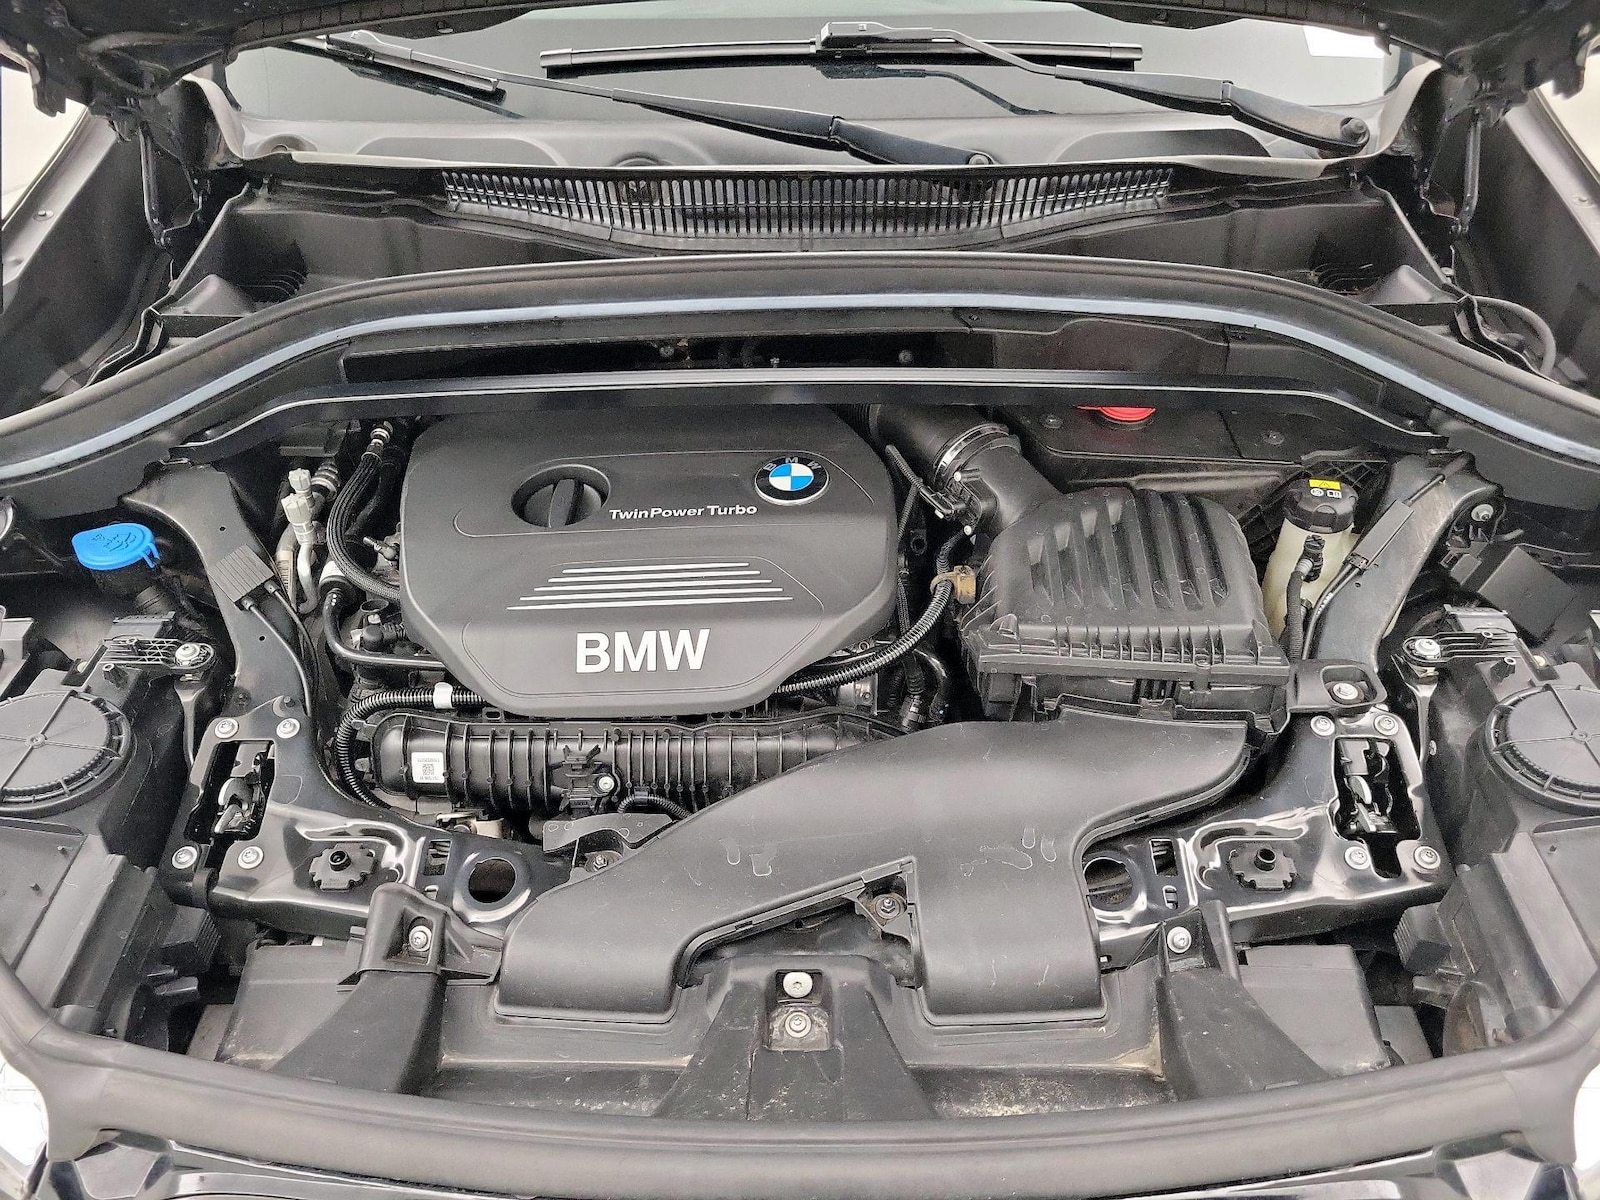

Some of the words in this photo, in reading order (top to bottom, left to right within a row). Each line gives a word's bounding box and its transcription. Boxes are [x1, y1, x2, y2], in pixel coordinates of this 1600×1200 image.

[763, 456, 822, 471] BMW
[707, 504, 758, 516] Turbo
[576, 628, 711, 673] BMW
